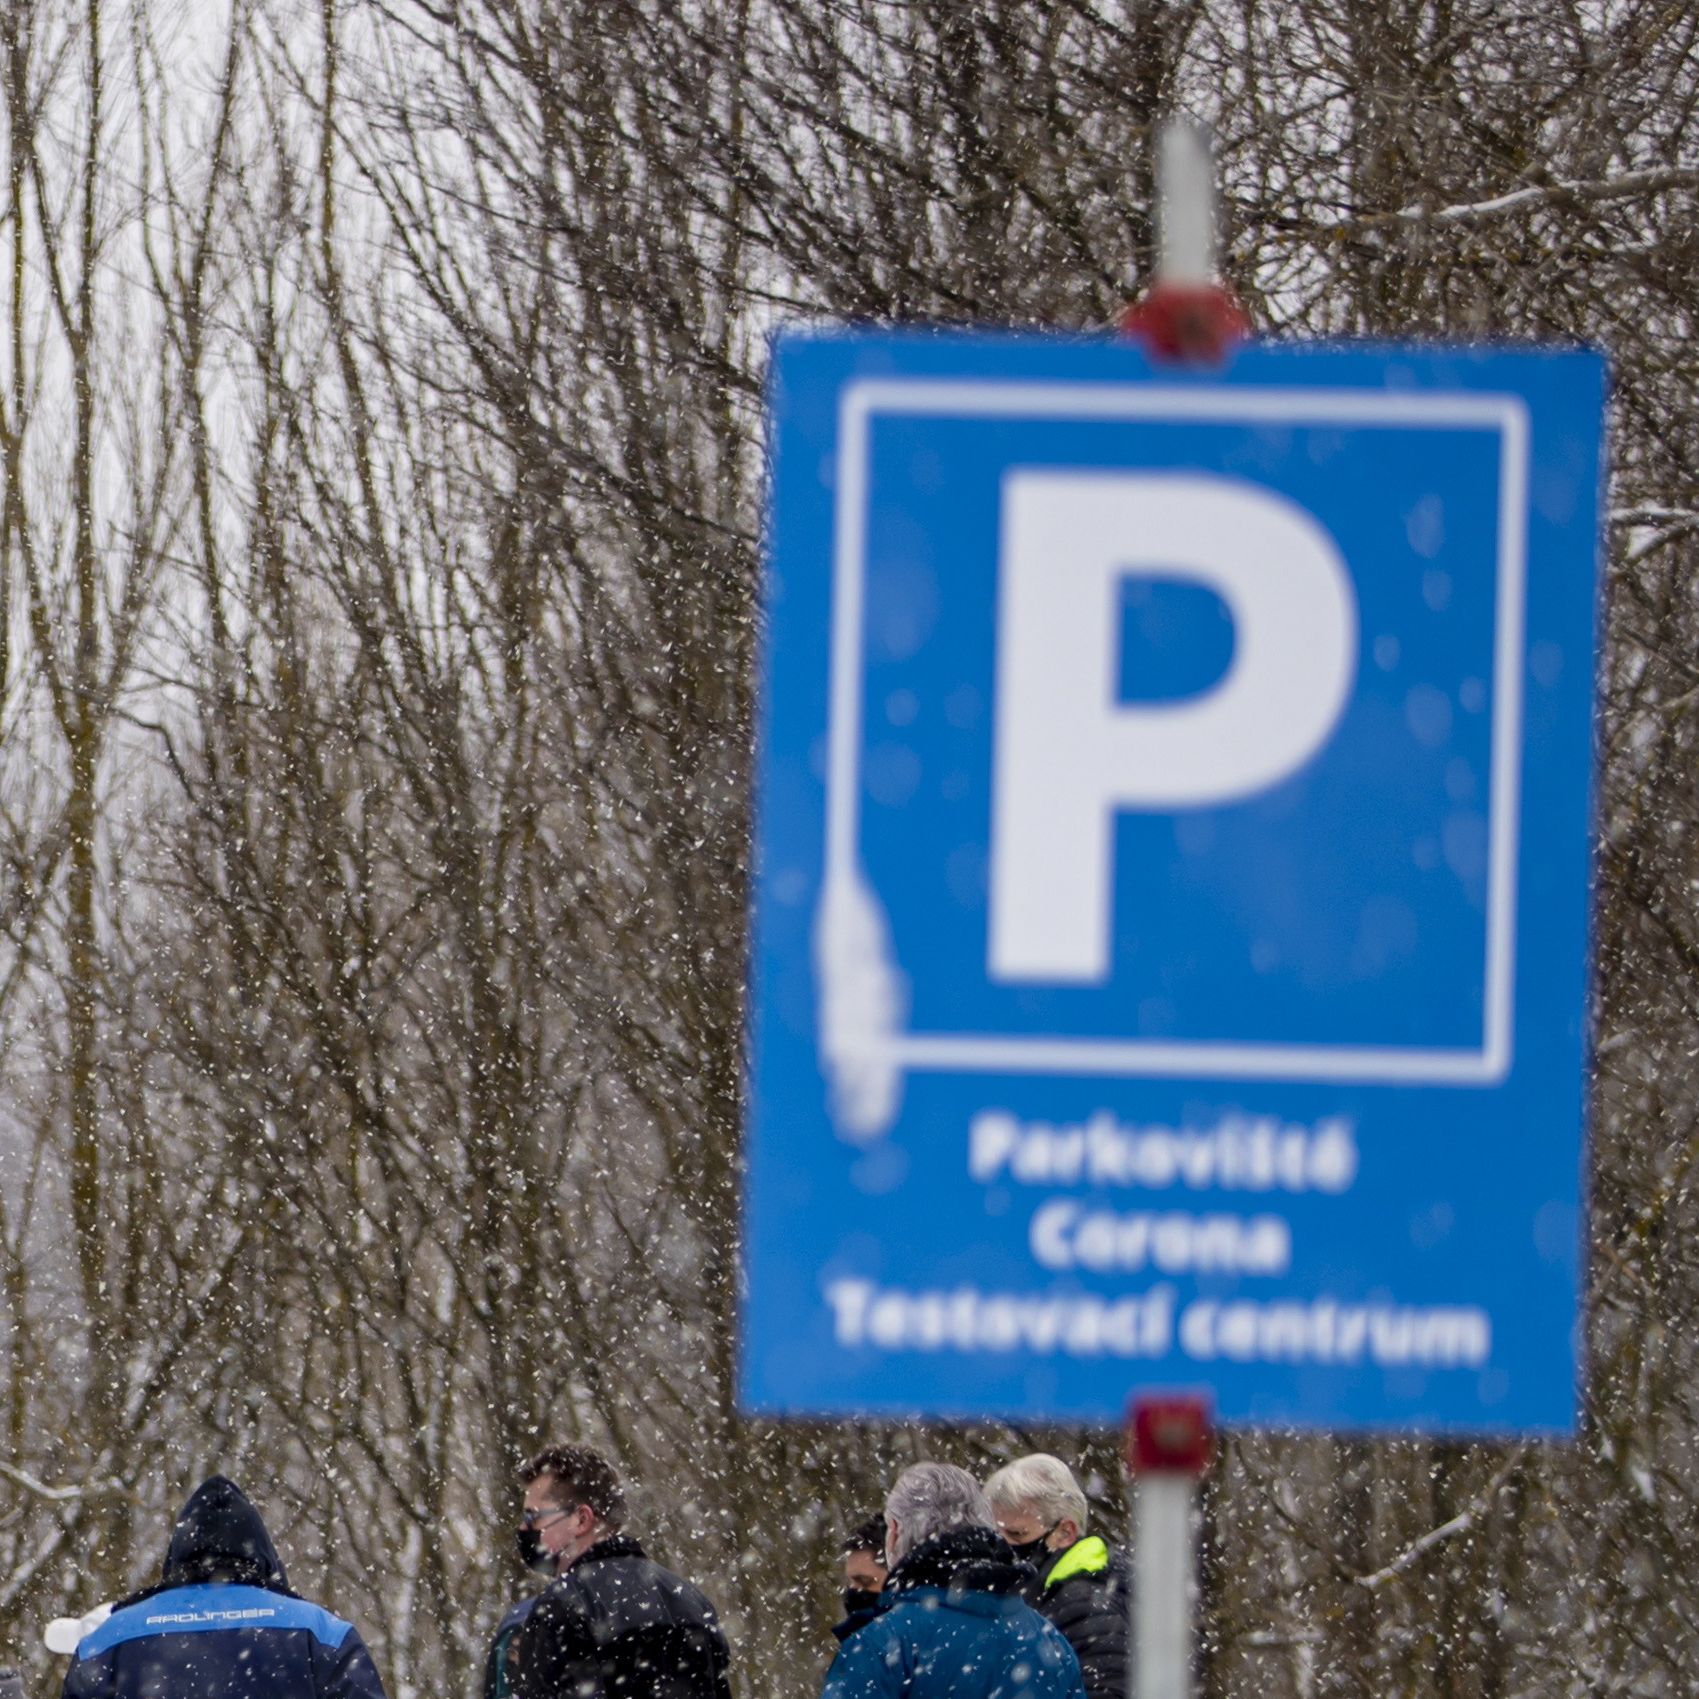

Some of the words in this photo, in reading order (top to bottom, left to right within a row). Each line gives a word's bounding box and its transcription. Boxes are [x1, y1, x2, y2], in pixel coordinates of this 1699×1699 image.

[989, 470, 1356, 982] P
[1031, 1202, 1289, 1271] Corona
[826, 1276, 1170, 1356] Testovací
[1180, 1300, 1489, 1364] centrum
